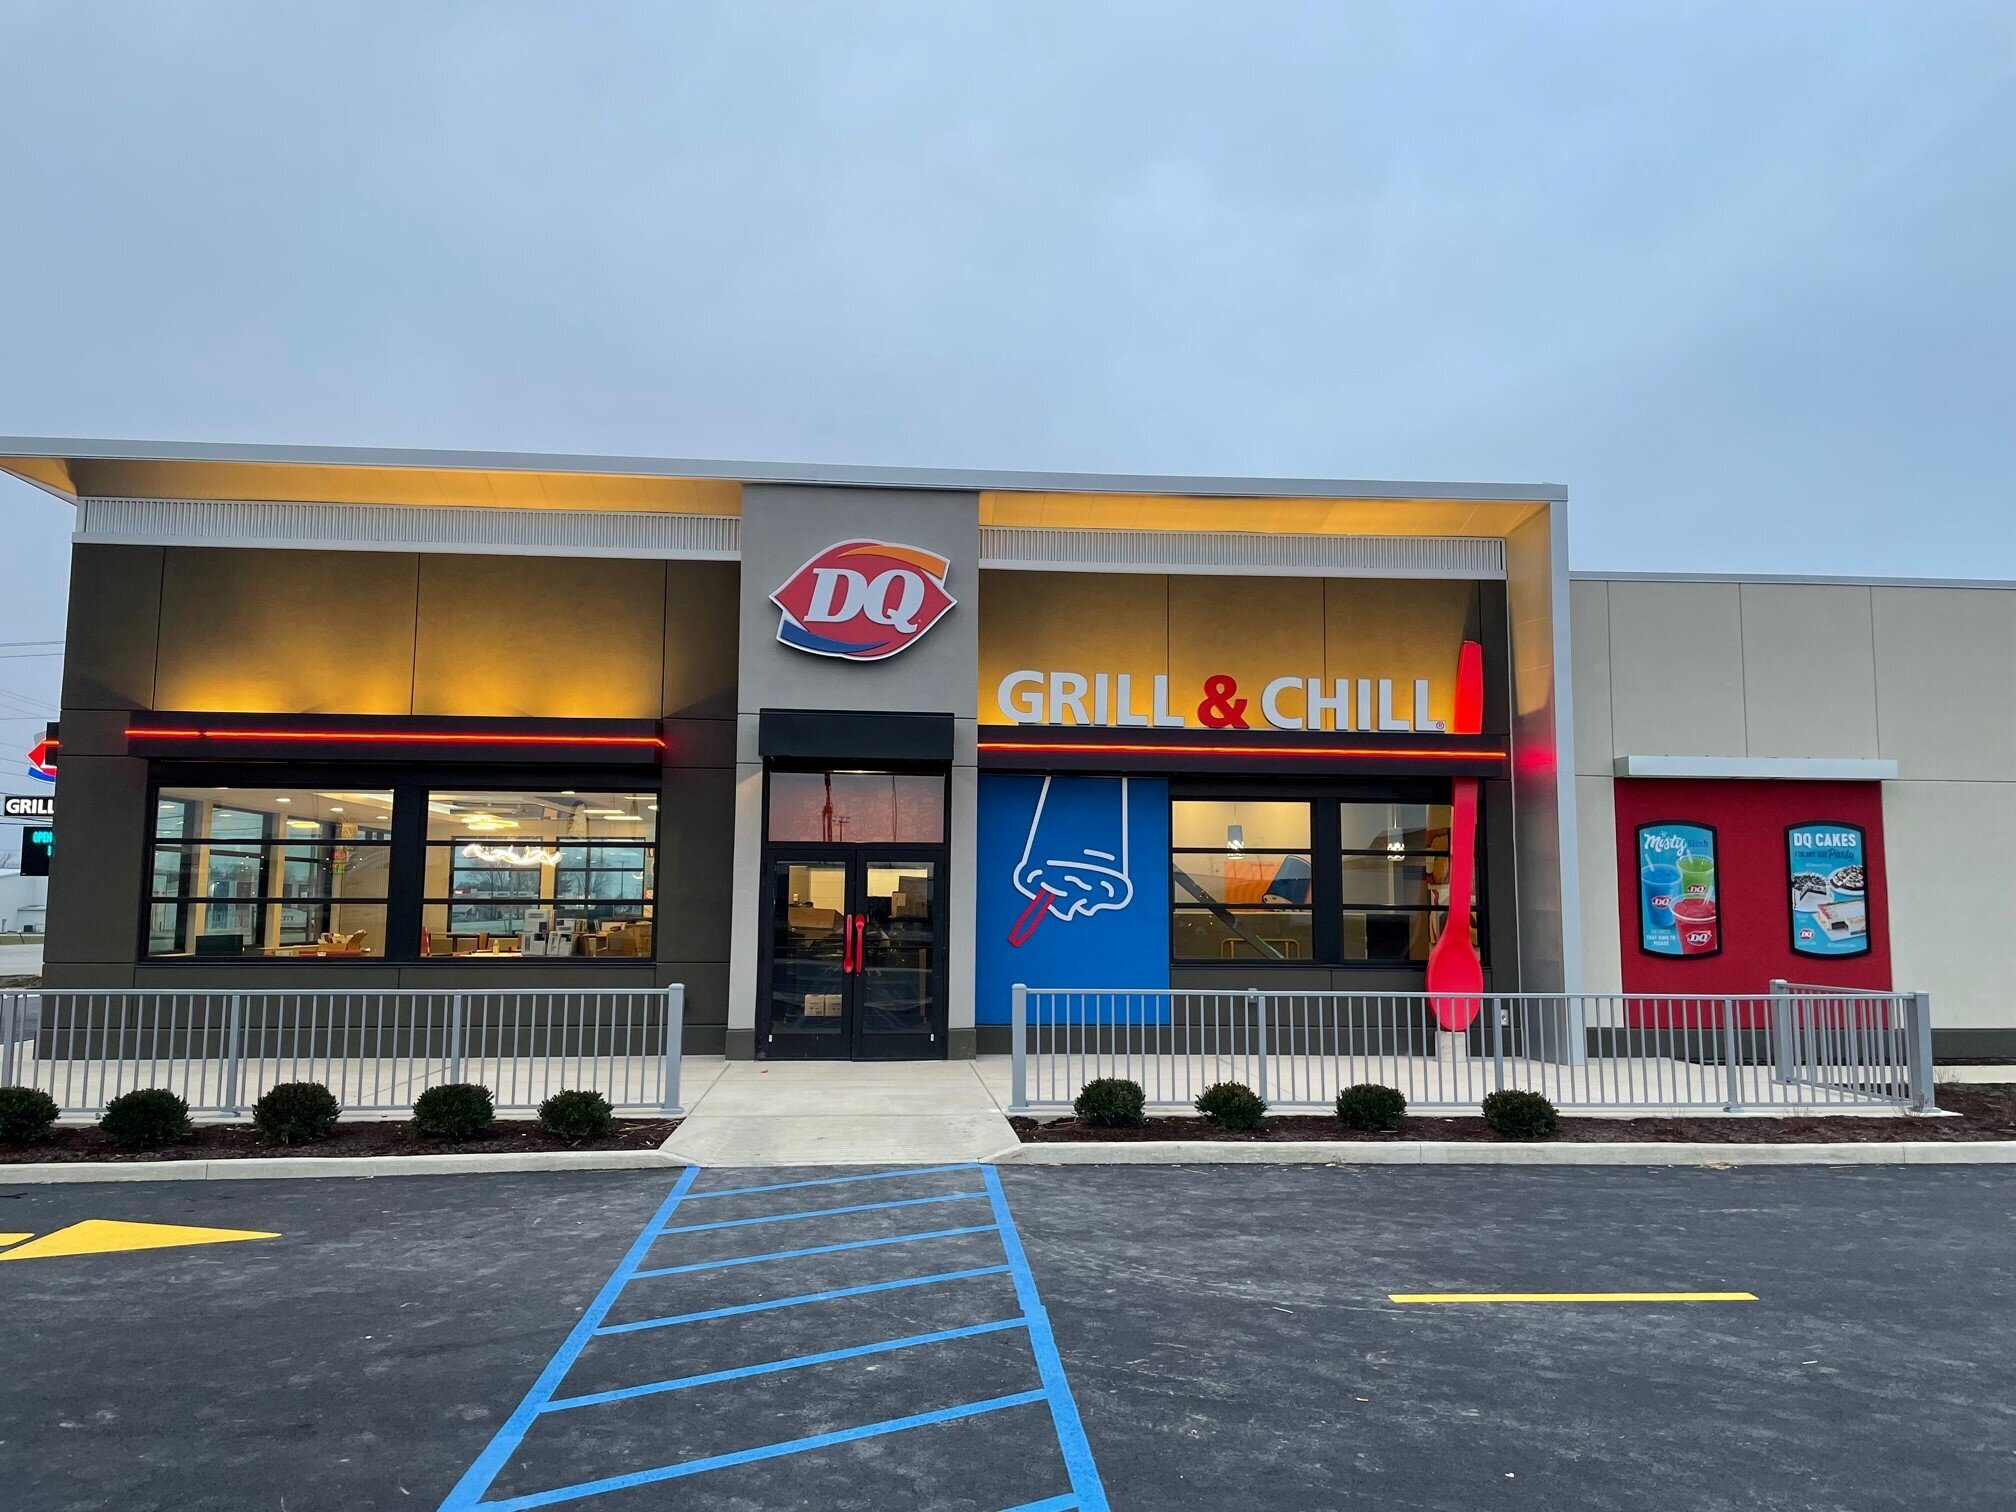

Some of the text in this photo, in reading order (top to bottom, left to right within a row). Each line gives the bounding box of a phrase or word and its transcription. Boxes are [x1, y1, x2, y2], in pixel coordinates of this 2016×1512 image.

[803, 567, 926, 634] DQ
[997, 670, 1185, 727] GRILL
[1196, 674, 1250, 729] &
[1793, 832, 1857, 849] DQ CAKES
[1689, 933, 1709, 942] DQ
